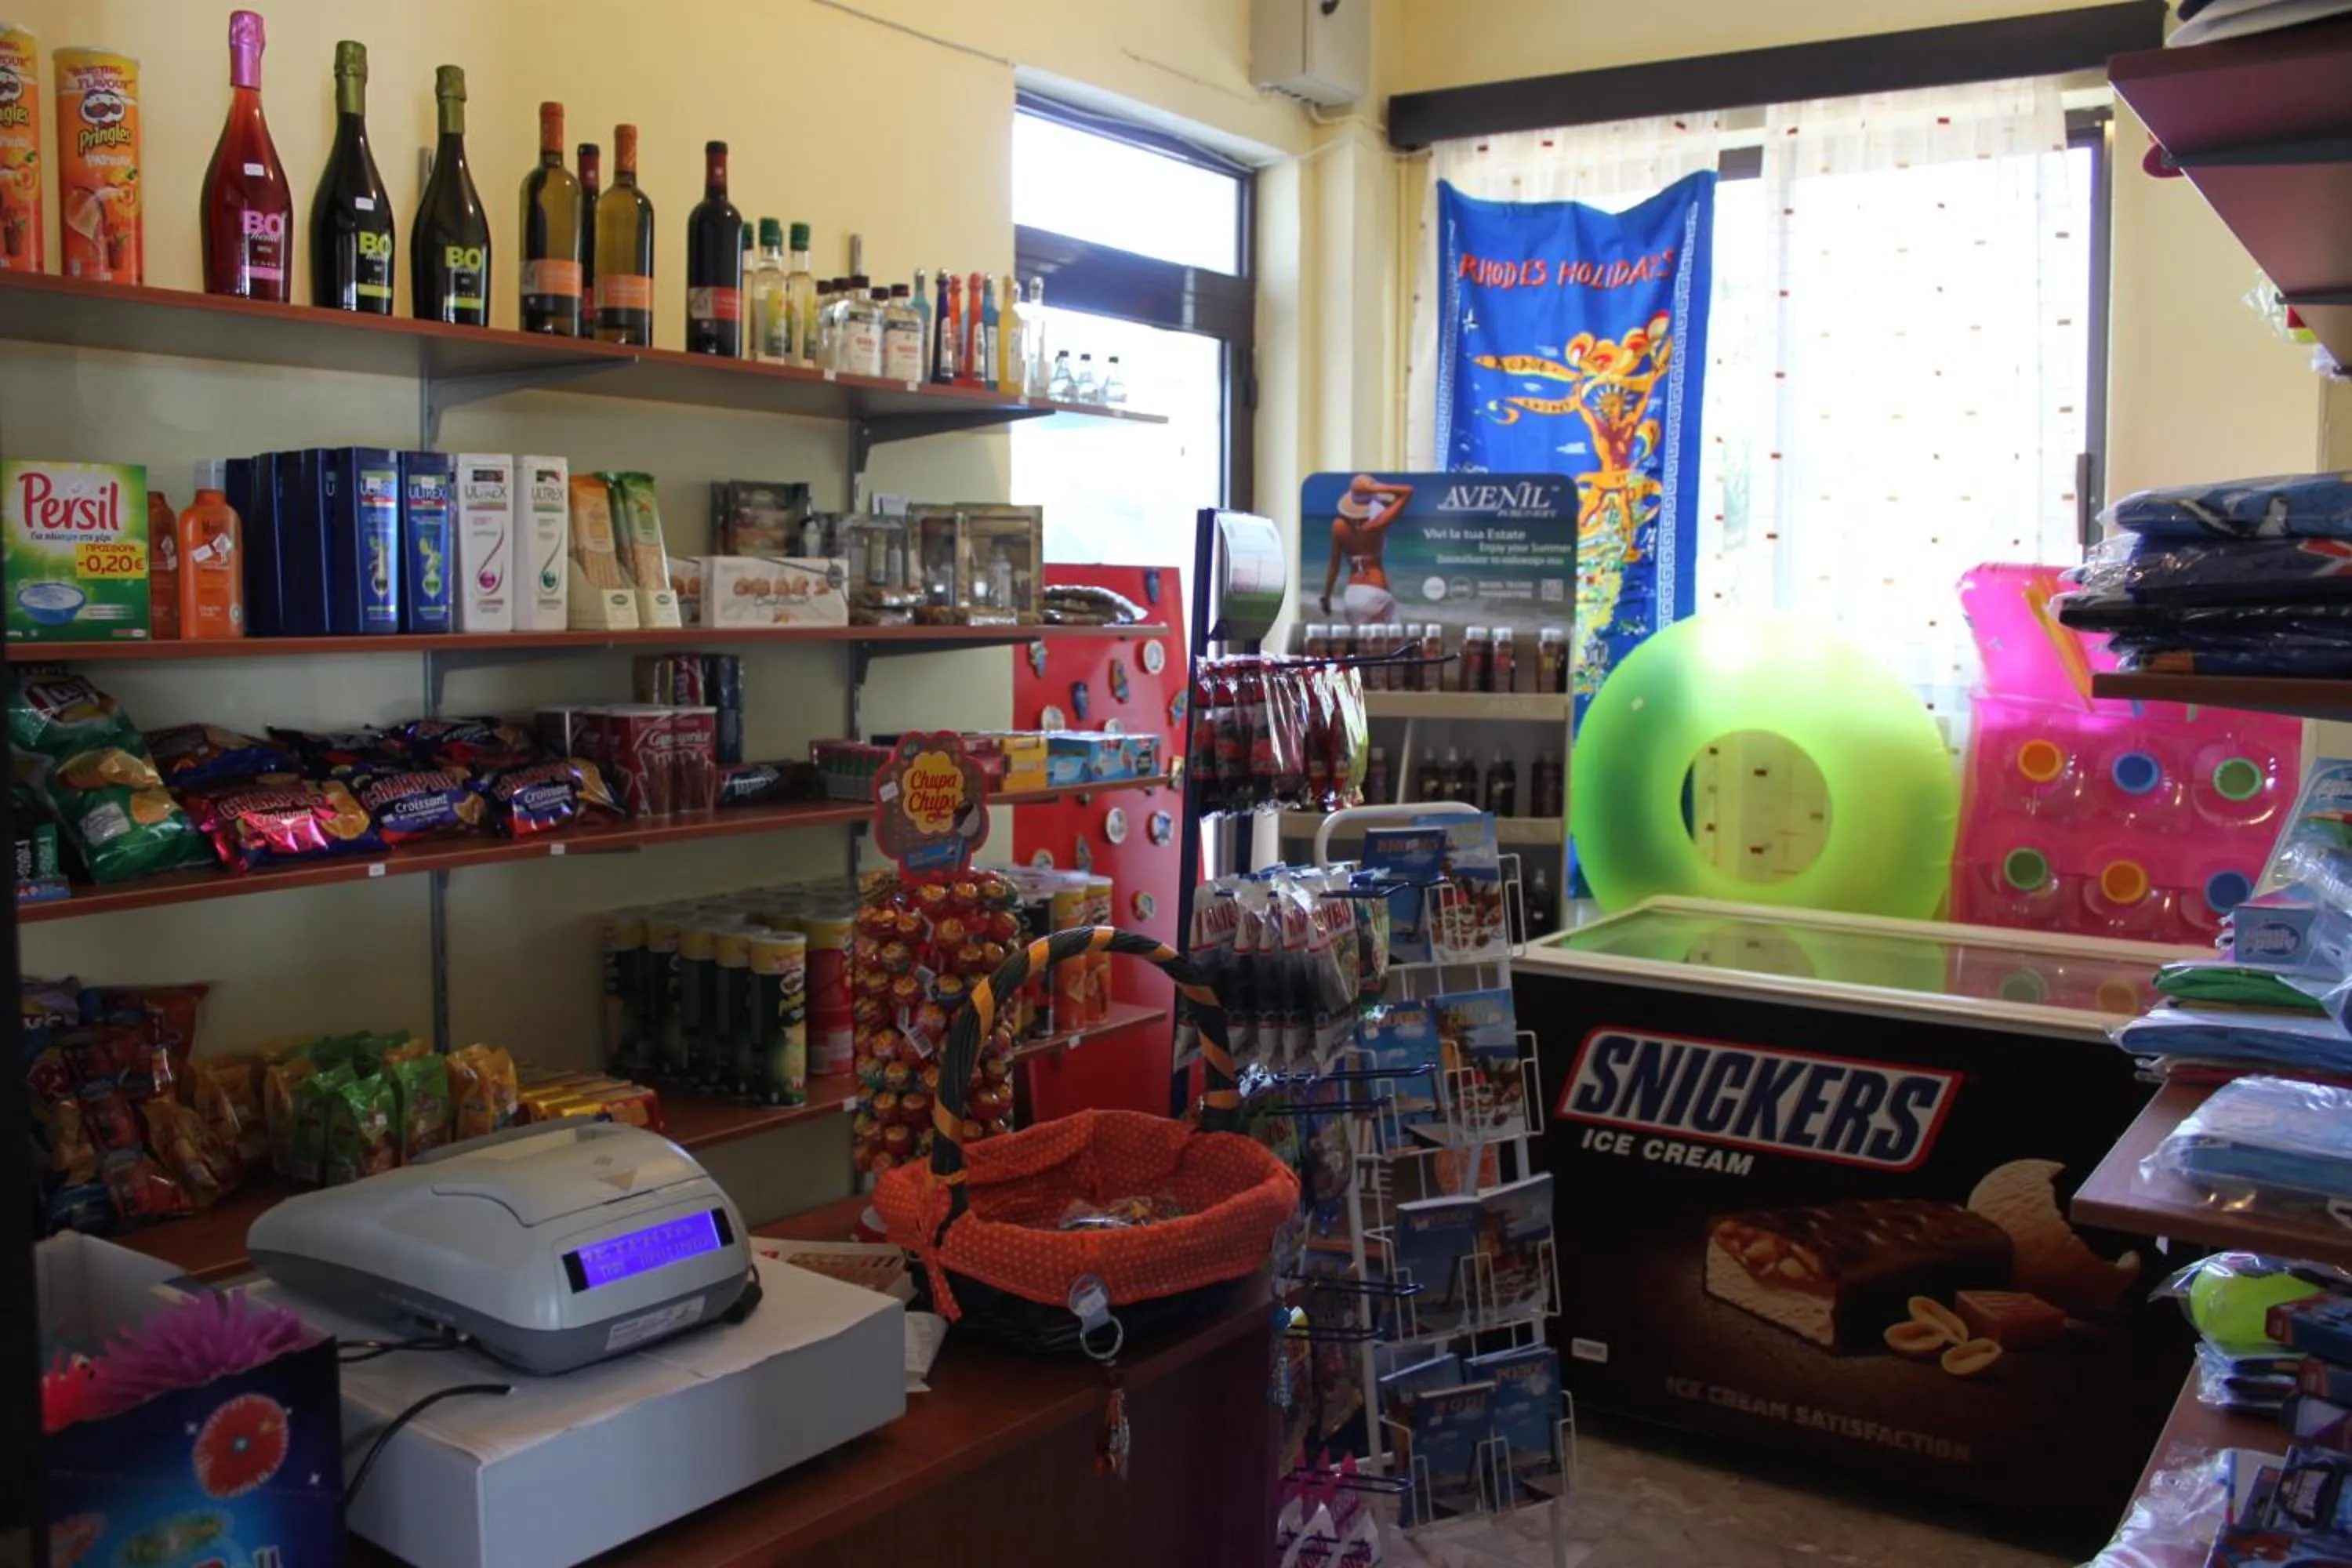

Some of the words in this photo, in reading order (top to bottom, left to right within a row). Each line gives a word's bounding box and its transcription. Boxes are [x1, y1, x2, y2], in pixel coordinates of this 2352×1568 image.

[78, 122, 132, 158] Pringles
[243, 209, 282, 235] BO
[359, 231, 392, 256] BO
[445, 245, 483, 271] BO
[1458, 252, 1548, 290] RHODES
[1557, 249, 1676, 290] HOLIDAYS
[18, 472, 120, 531] Persil
[1436, 481, 1552, 512] AVENIL
[1450, 528, 1461, 539] la
[1463, 529, 1485, 539] tua
[1487, 528, 1526, 541] Estate
[910, 771, 957, 793] Chupa
[394, 793, 448, 814] Croissant
[909, 790, 956, 815] Chups
[1571, 1034, 1943, 1163] SNICKERS
[1581, 1129, 1635, 1156] ICE
[1642, 1139, 1755, 1176] CREAM
[1665, 1374, 1704, 1401] ICE
[1707, 1384, 1789, 1421] CREAM
[1794, 1405, 1973, 1465] SATISFACTION
